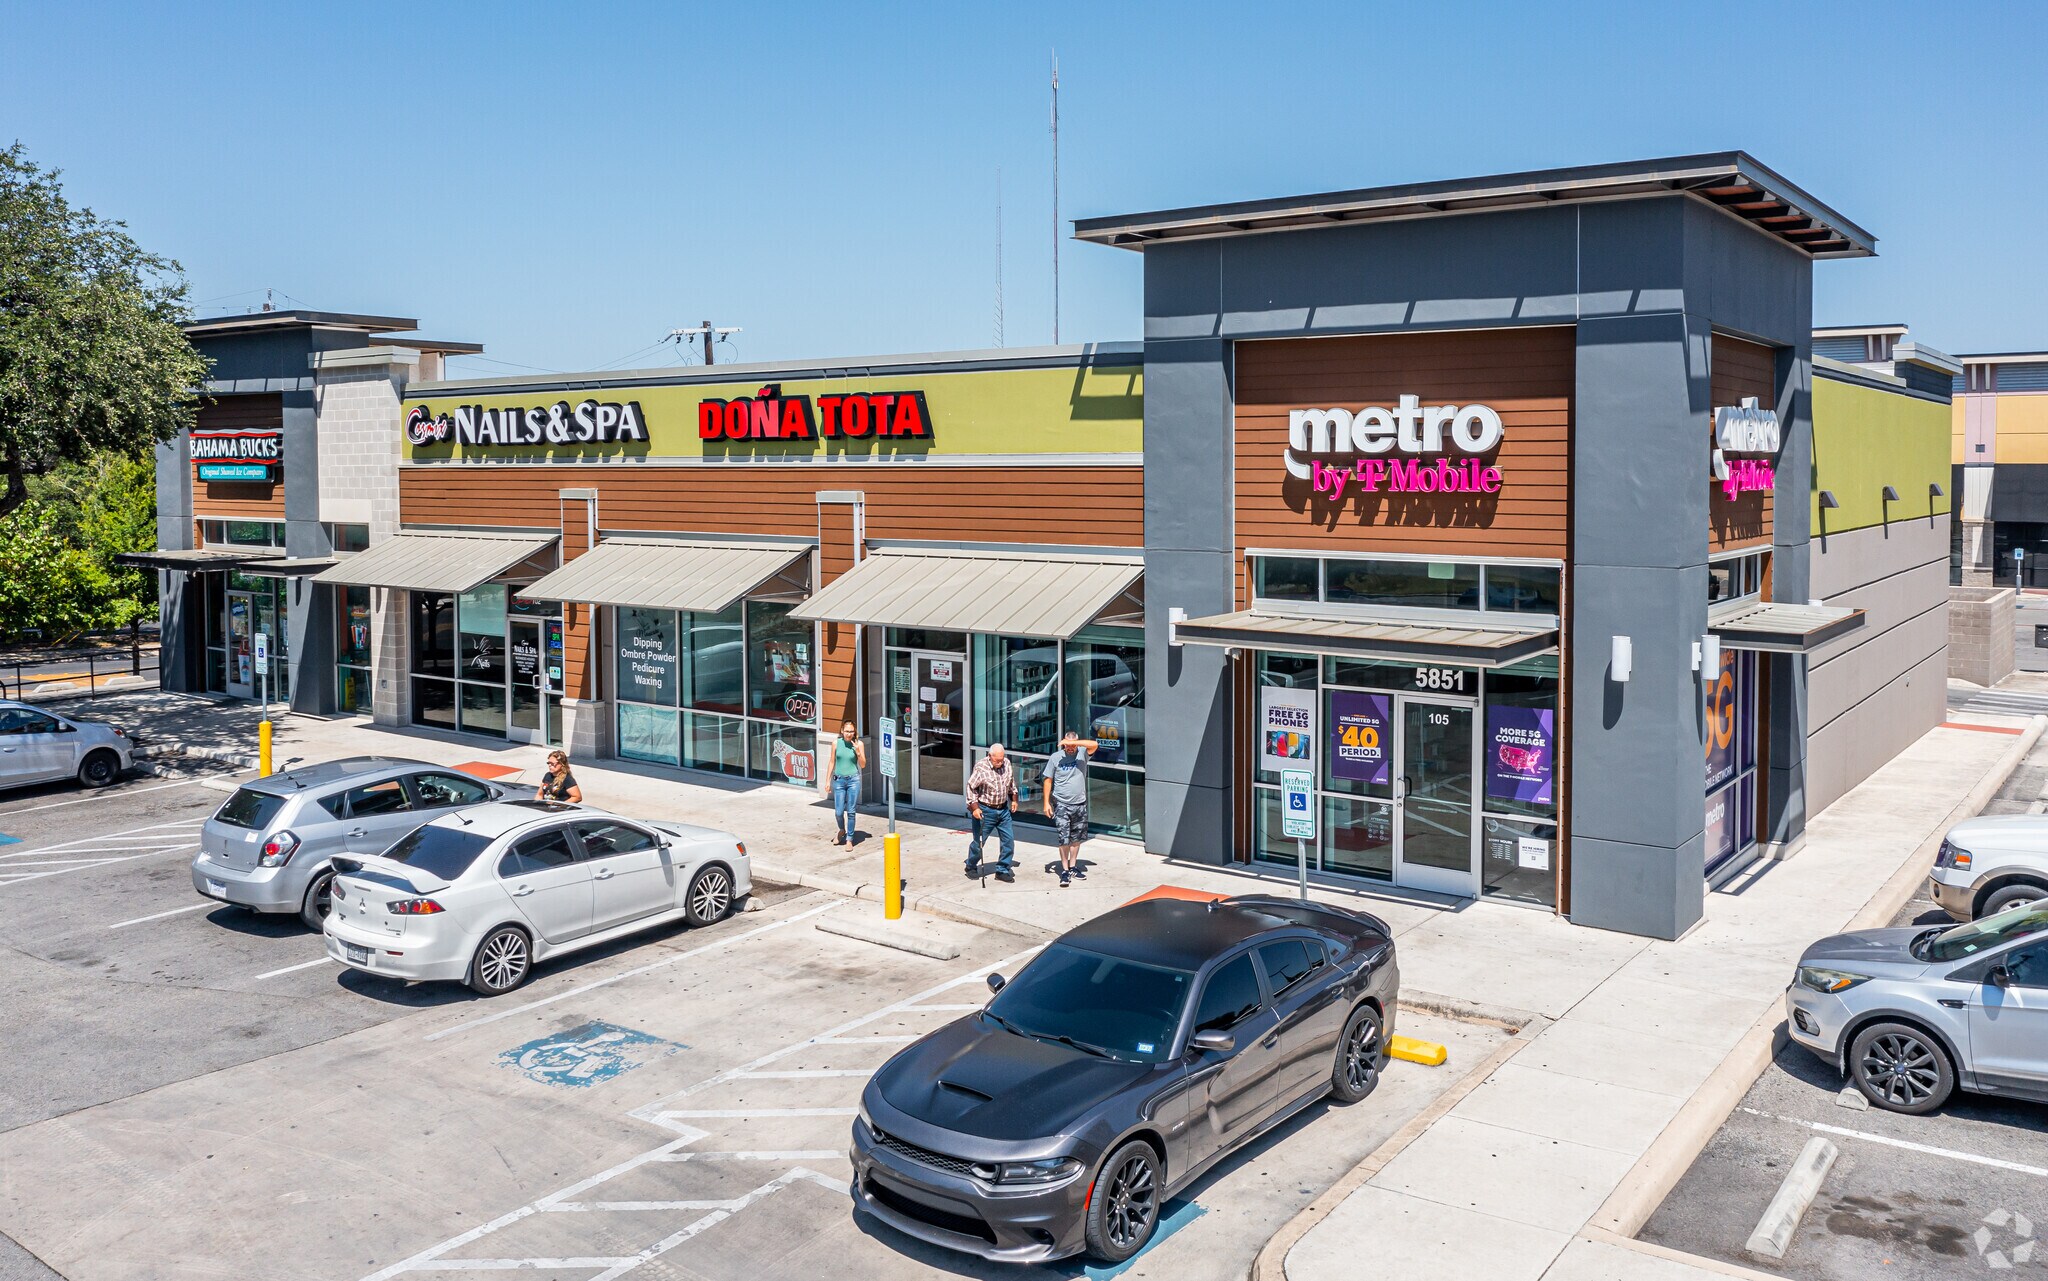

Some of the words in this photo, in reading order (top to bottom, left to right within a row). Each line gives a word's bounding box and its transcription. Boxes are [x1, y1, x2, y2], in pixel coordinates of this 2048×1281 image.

[699, 387, 809, 438] DOÑA
[817, 395, 924, 436] TOTA
[1288, 394, 1504, 453] metro
[190, 438, 238, 457] BAHAMA
[241, 438, 277, 457] BUCK'S
[243, 467, 264, 478] Company
[1312, 459, 1352, 501] by
[633, 637, 663, 650] Dipping
[647, 651, 676, 662] Powder
[632, 662, 665, 674] Pedicure
[634, 675, 662, 688] Waxing
[1415, 668, 1464, 691] 5851
[787, 698, 816, 717] OPEN
[1269, 709, 1294, 719] FREE
[1296, 712, 1309, 720] 5G
[1340, 715, 1371, 724] UNLIMITED
[1428, 713, 1450, 726] 105
[1269, 717, 1309, 729] PHONES
[1338, 725, 1379, 748] $40
[1500, 727, 1527, 737] MORE
[1529, 730, 1541, 738] 5G
[1495, 735, 1546, 747] COVERAGE
[1341, 747, 1380, 757] PERIOD.
[1285, 777, 1310, 786] RESERVED
[1287, 785, 1309, 793] PARKING
